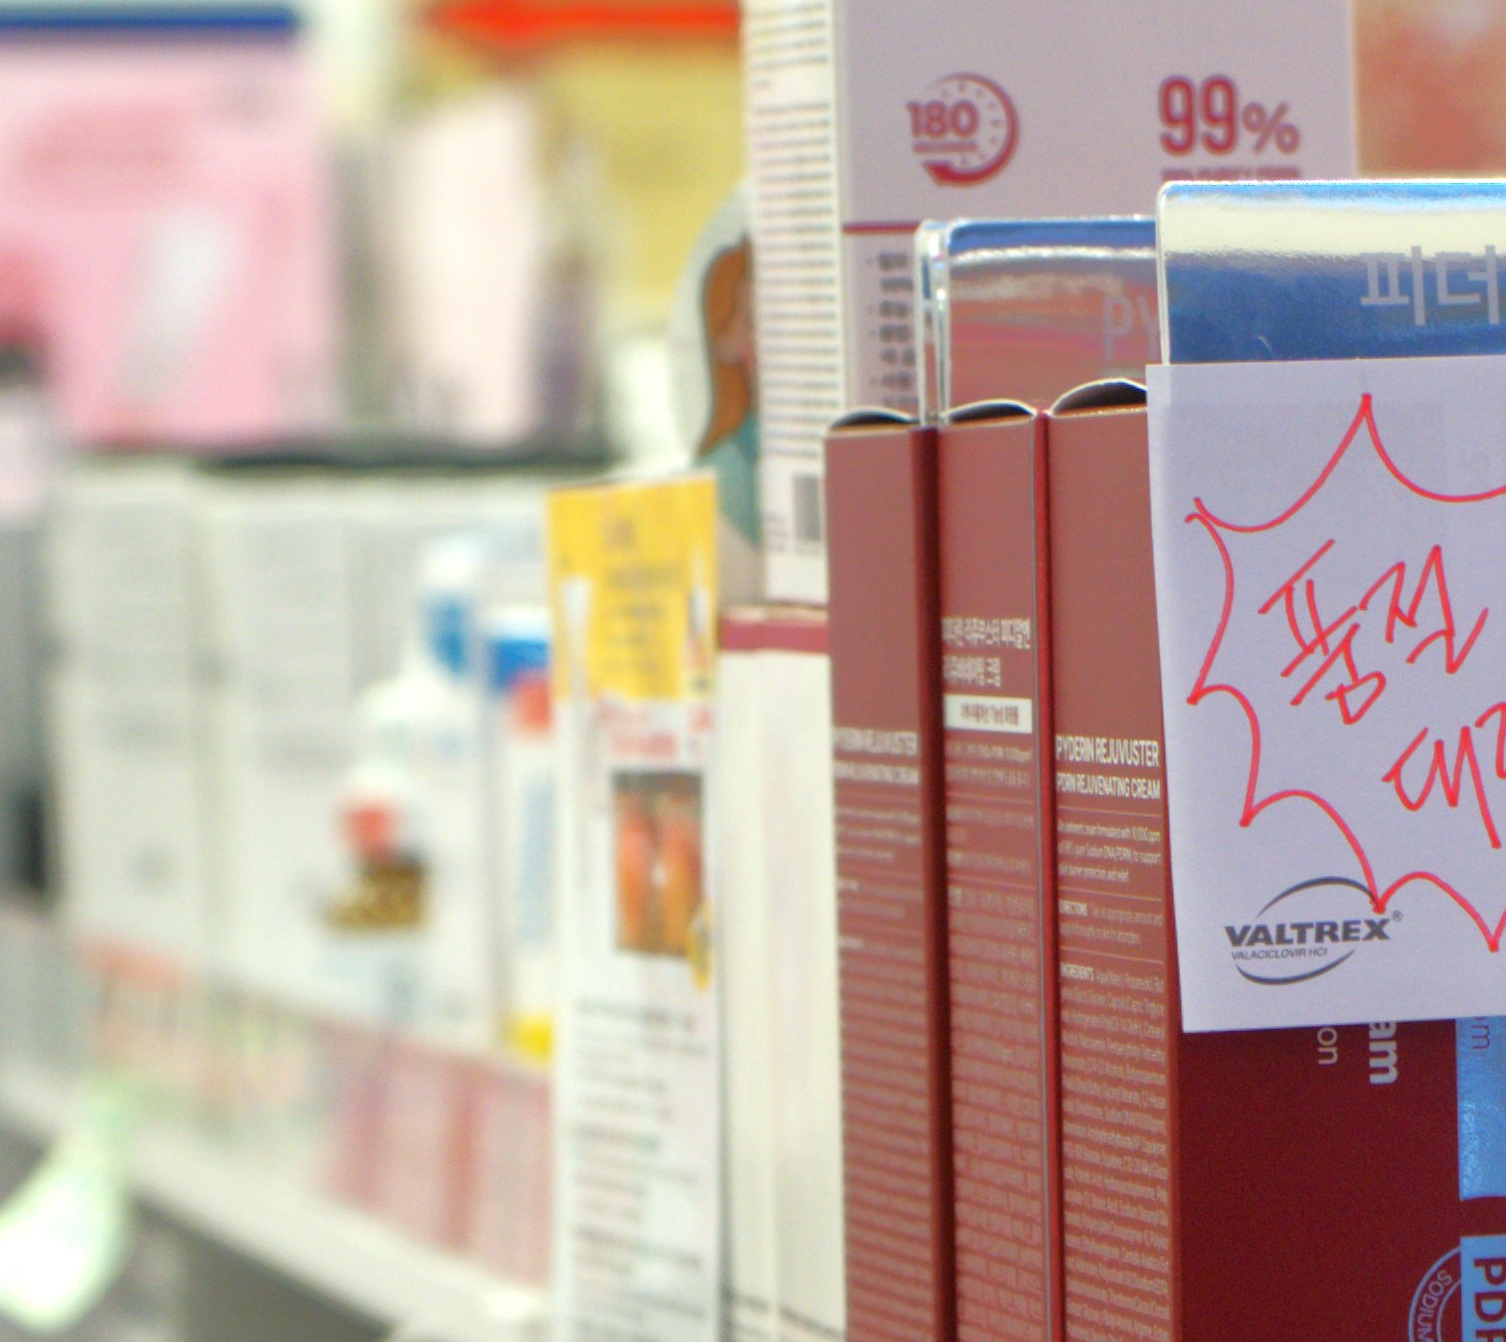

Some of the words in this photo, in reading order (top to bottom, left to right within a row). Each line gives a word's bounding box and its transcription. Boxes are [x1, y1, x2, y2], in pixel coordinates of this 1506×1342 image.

[906, 99, 980, 140] 180
[1158, 73, 1302, 156] 99%
[1224, 917, 1392, 948] VALTREX
